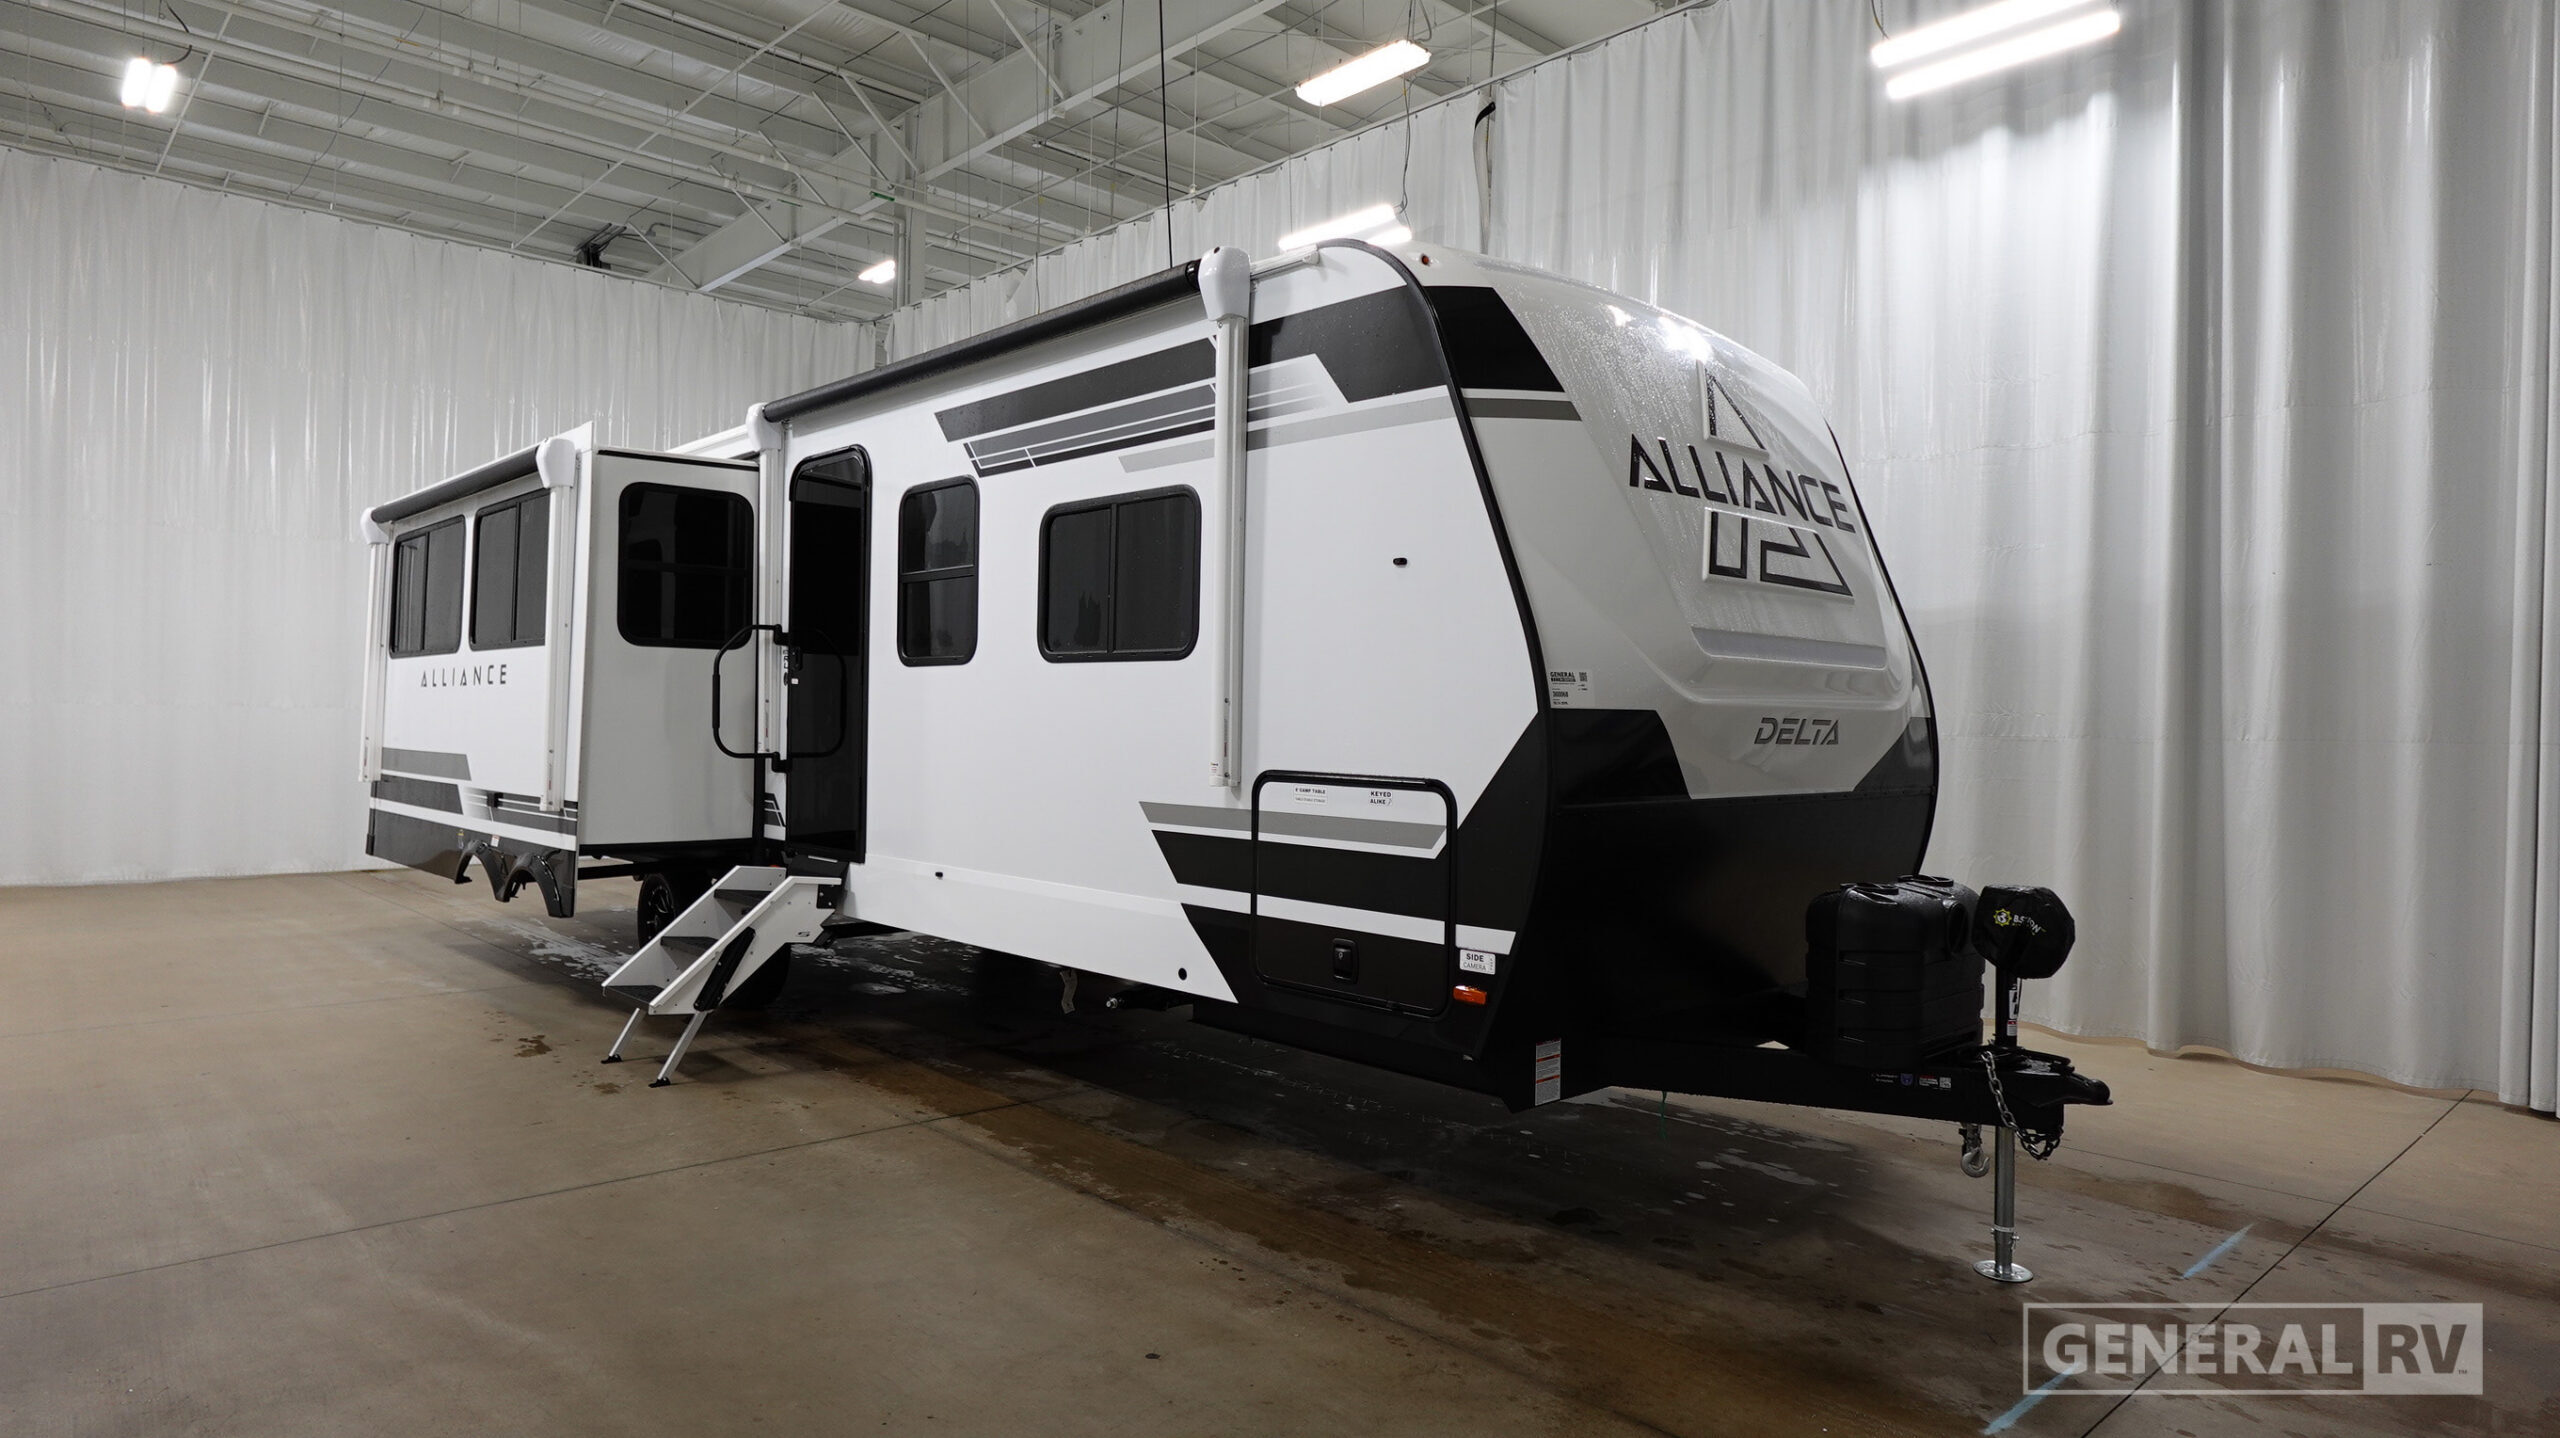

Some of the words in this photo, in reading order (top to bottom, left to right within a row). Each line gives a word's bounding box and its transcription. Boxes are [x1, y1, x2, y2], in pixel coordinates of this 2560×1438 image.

[1629, 433, 1856, 534] ALLIANCE
[420, 664, 507, 687] ALLIANCE
[1754, 717, 1840, 745] DELTA
[1463, 962, 1486, 970] CAMERA
[1466, 953, 1484, 962] SIDE
